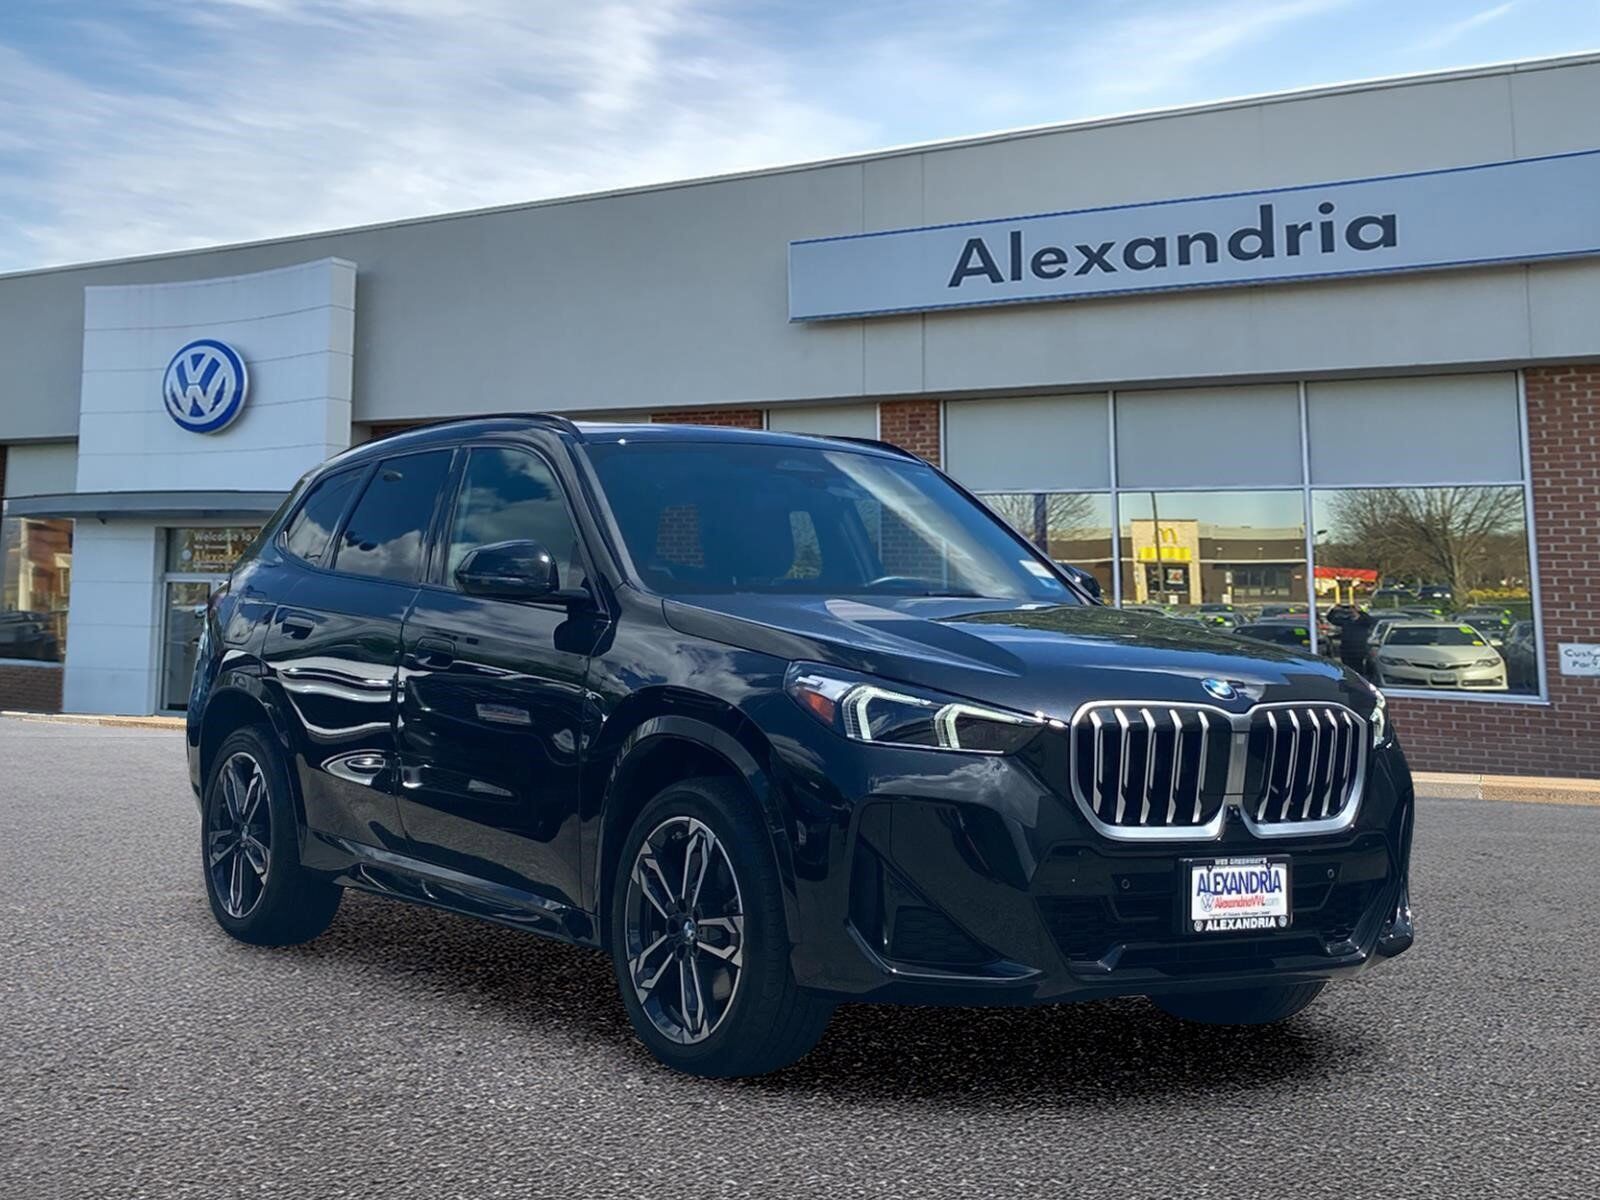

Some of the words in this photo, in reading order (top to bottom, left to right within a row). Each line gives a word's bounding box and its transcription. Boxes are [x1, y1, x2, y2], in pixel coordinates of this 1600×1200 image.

[948, 202, 1398, 287] Alexandria
[1197, 869, 1282, 896] ALEXANDRIA
[1205, 917, 1276, 931] ALEXANDRIA
